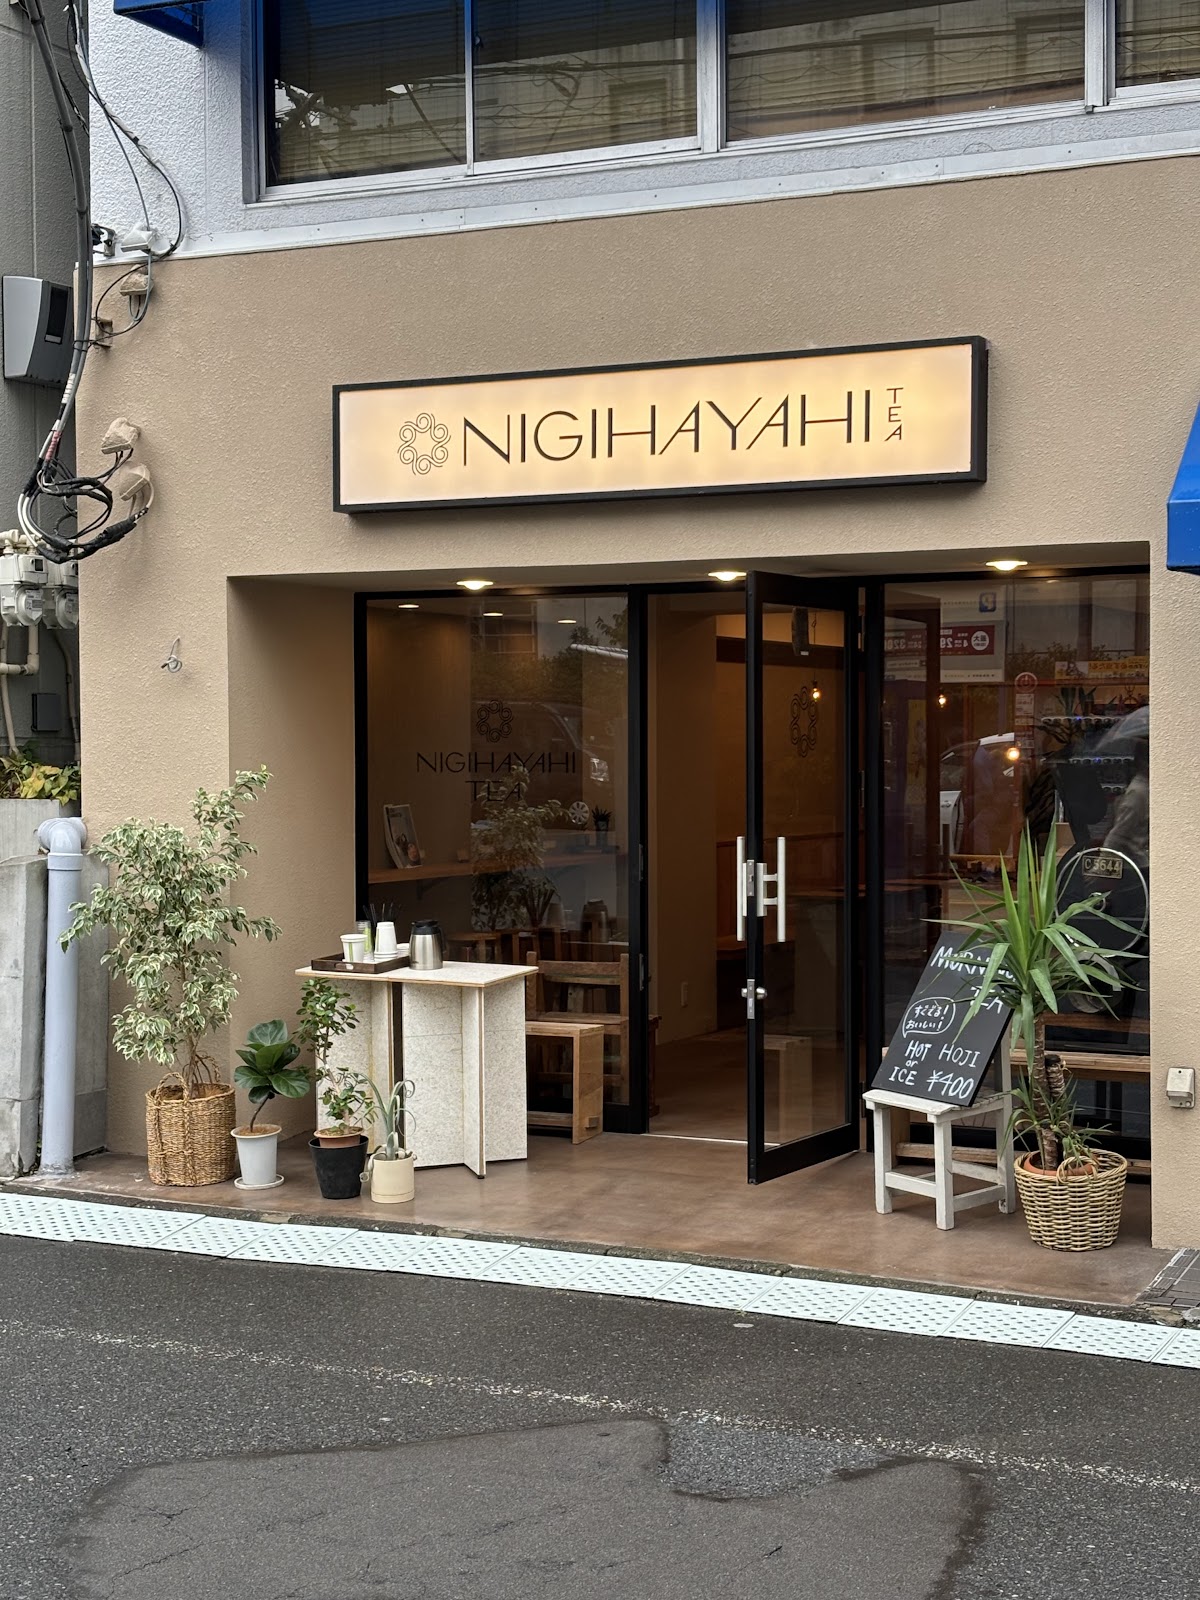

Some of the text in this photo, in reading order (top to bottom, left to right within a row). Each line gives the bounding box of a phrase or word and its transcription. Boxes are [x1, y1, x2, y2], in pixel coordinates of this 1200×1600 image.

[885, 387, 904, 442] TEA
[463, 389, 871, 467] NIGIHAYAHI
[416, 751, 576, 774] NIGIHAYAHI
[465, 780, 521, 802] TEA
[905, 1019, 943, 1031] おいしい!
[904, 1040, 981, 1068] HOT HOJI
[905, 1059, 919, 1068] or
[888, 1066, 975, 1100] ICE ¥400
